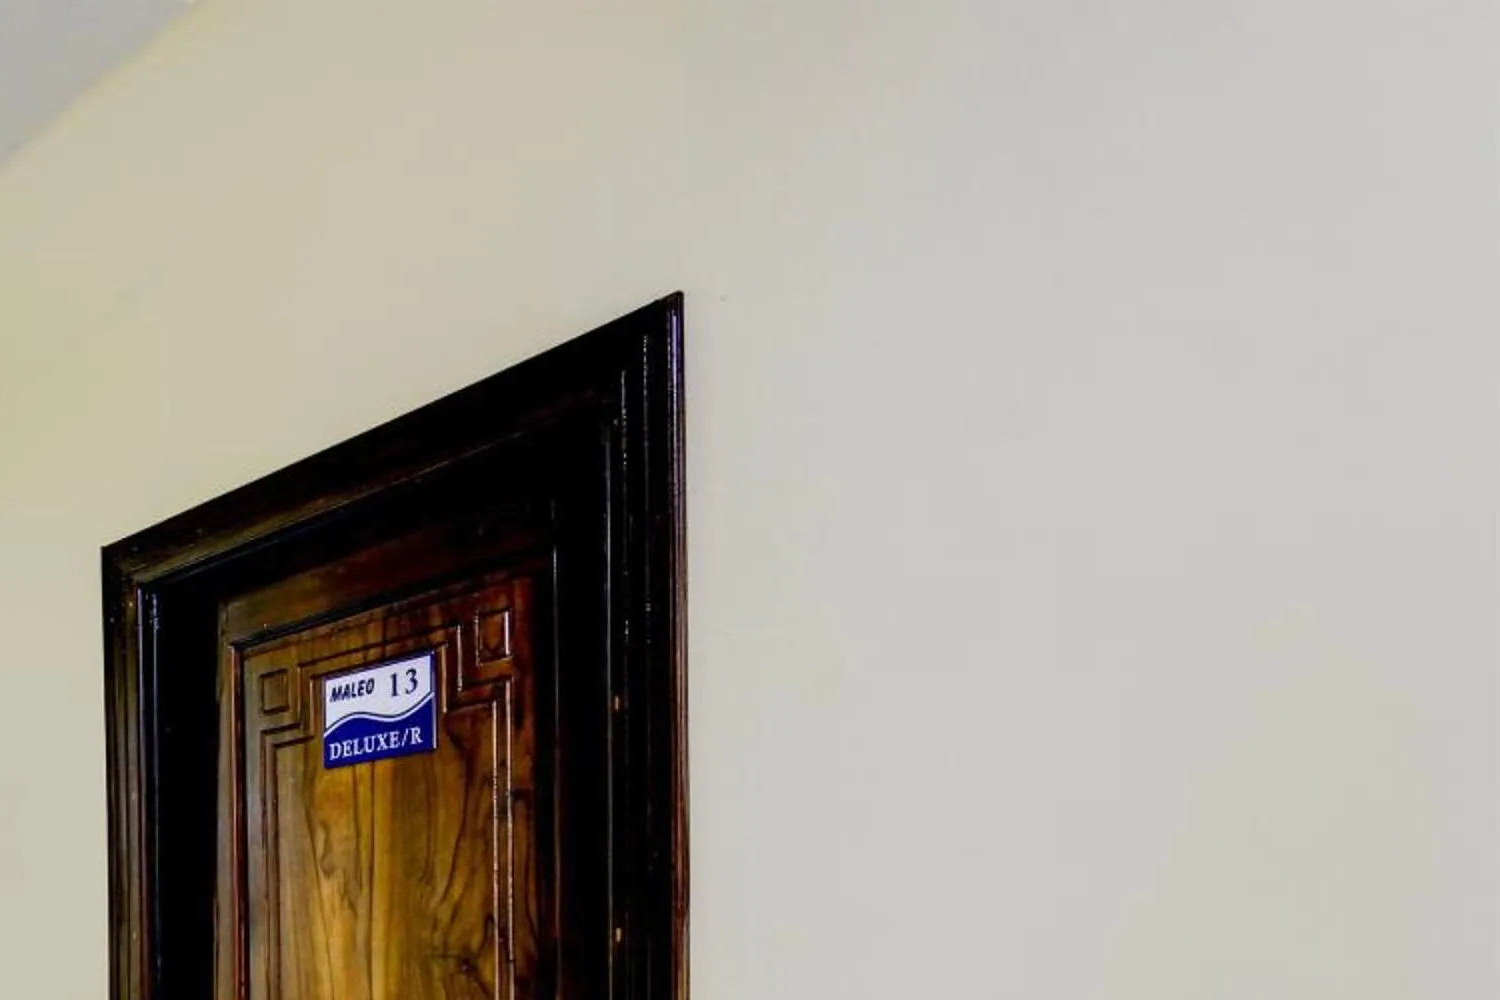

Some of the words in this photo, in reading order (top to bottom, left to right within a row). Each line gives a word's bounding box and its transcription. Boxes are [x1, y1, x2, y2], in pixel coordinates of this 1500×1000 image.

[330, 678, 375, 702] MALEO
[390, 668, 419, 697] 13
[329, 727, 423, 760] DELUXE/R
